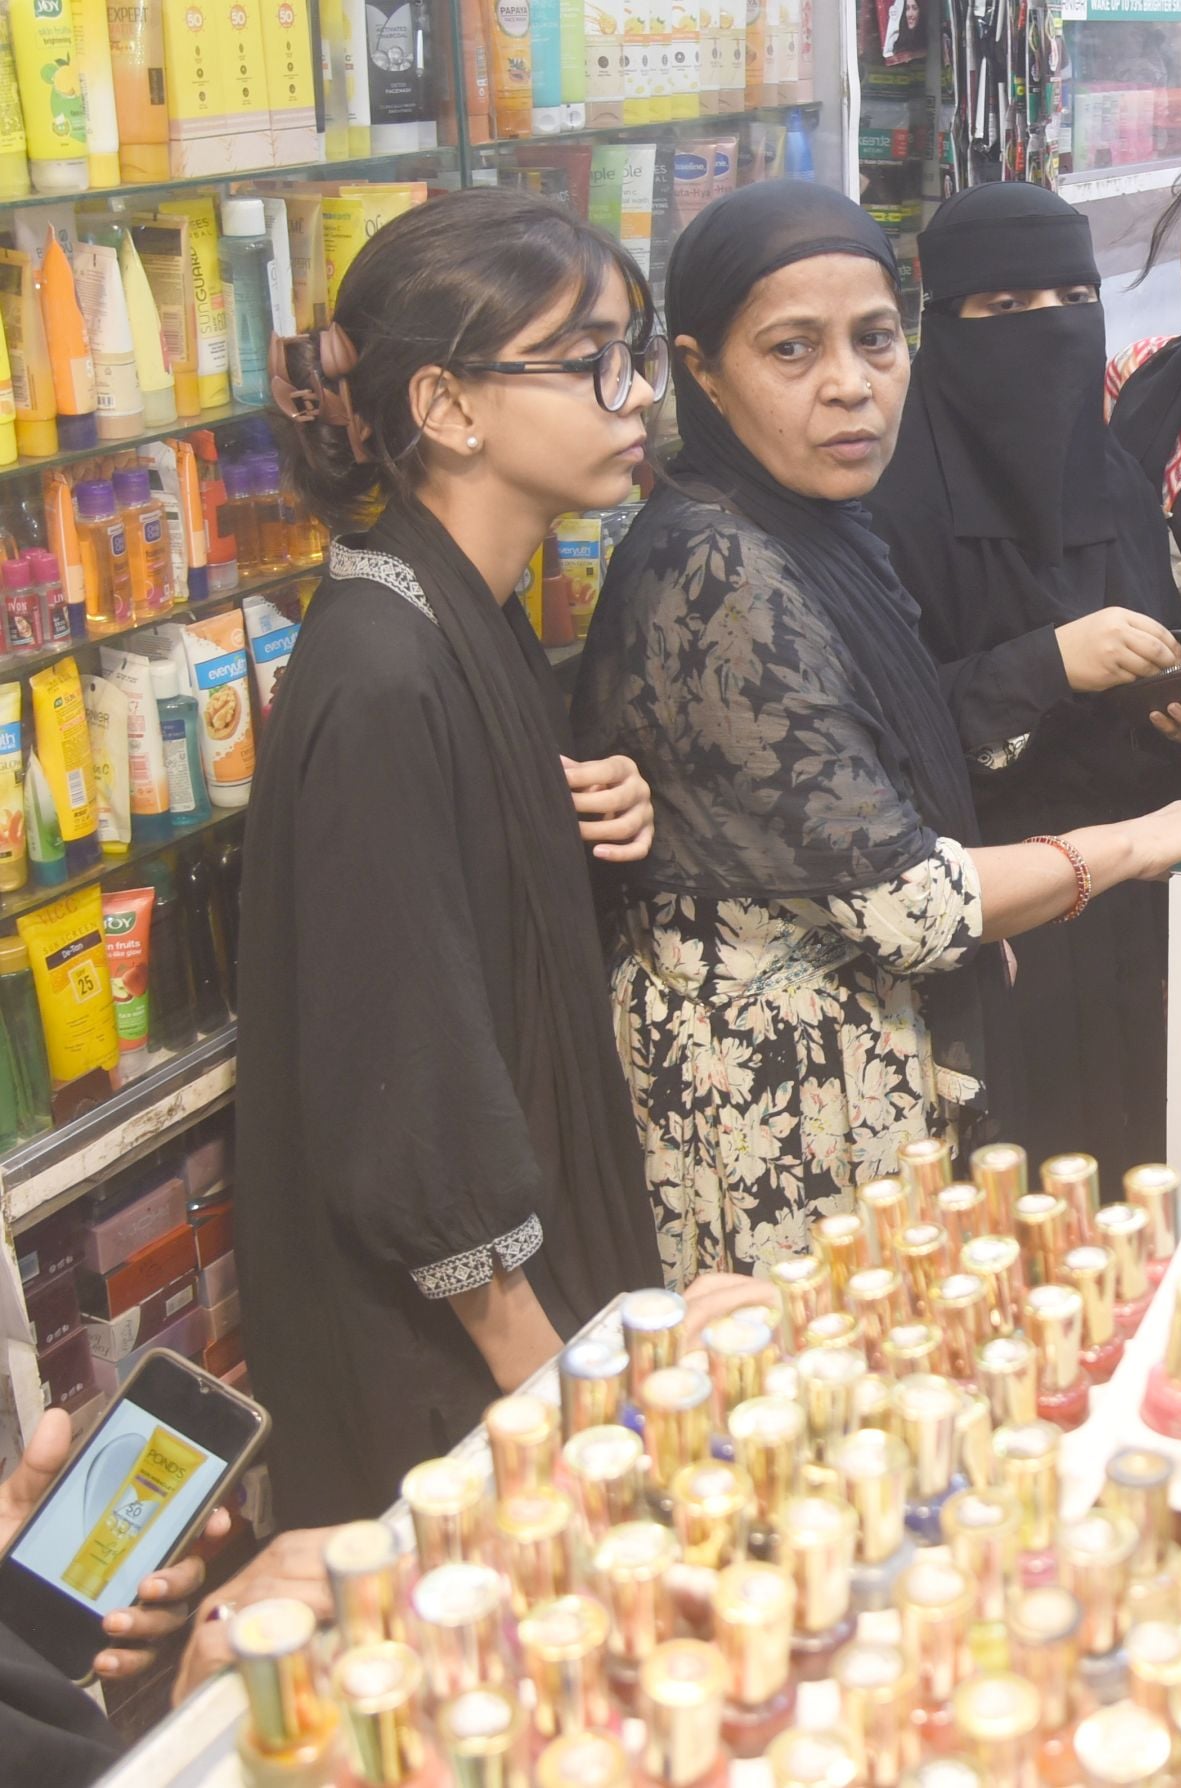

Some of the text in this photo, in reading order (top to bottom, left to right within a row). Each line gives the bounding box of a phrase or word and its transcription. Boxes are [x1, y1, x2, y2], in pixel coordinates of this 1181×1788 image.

[107, 7, 149, 23] EXPERT
[231, 10, 246, 24] 50
[279, 9, 293, 22] 50
[500, 6, 528, 15] PAPAYA
[115, 940, 141, 950] fruits
[77, 975, 95, 996] 25
[146, 1448, 187, 1480] POND'S
